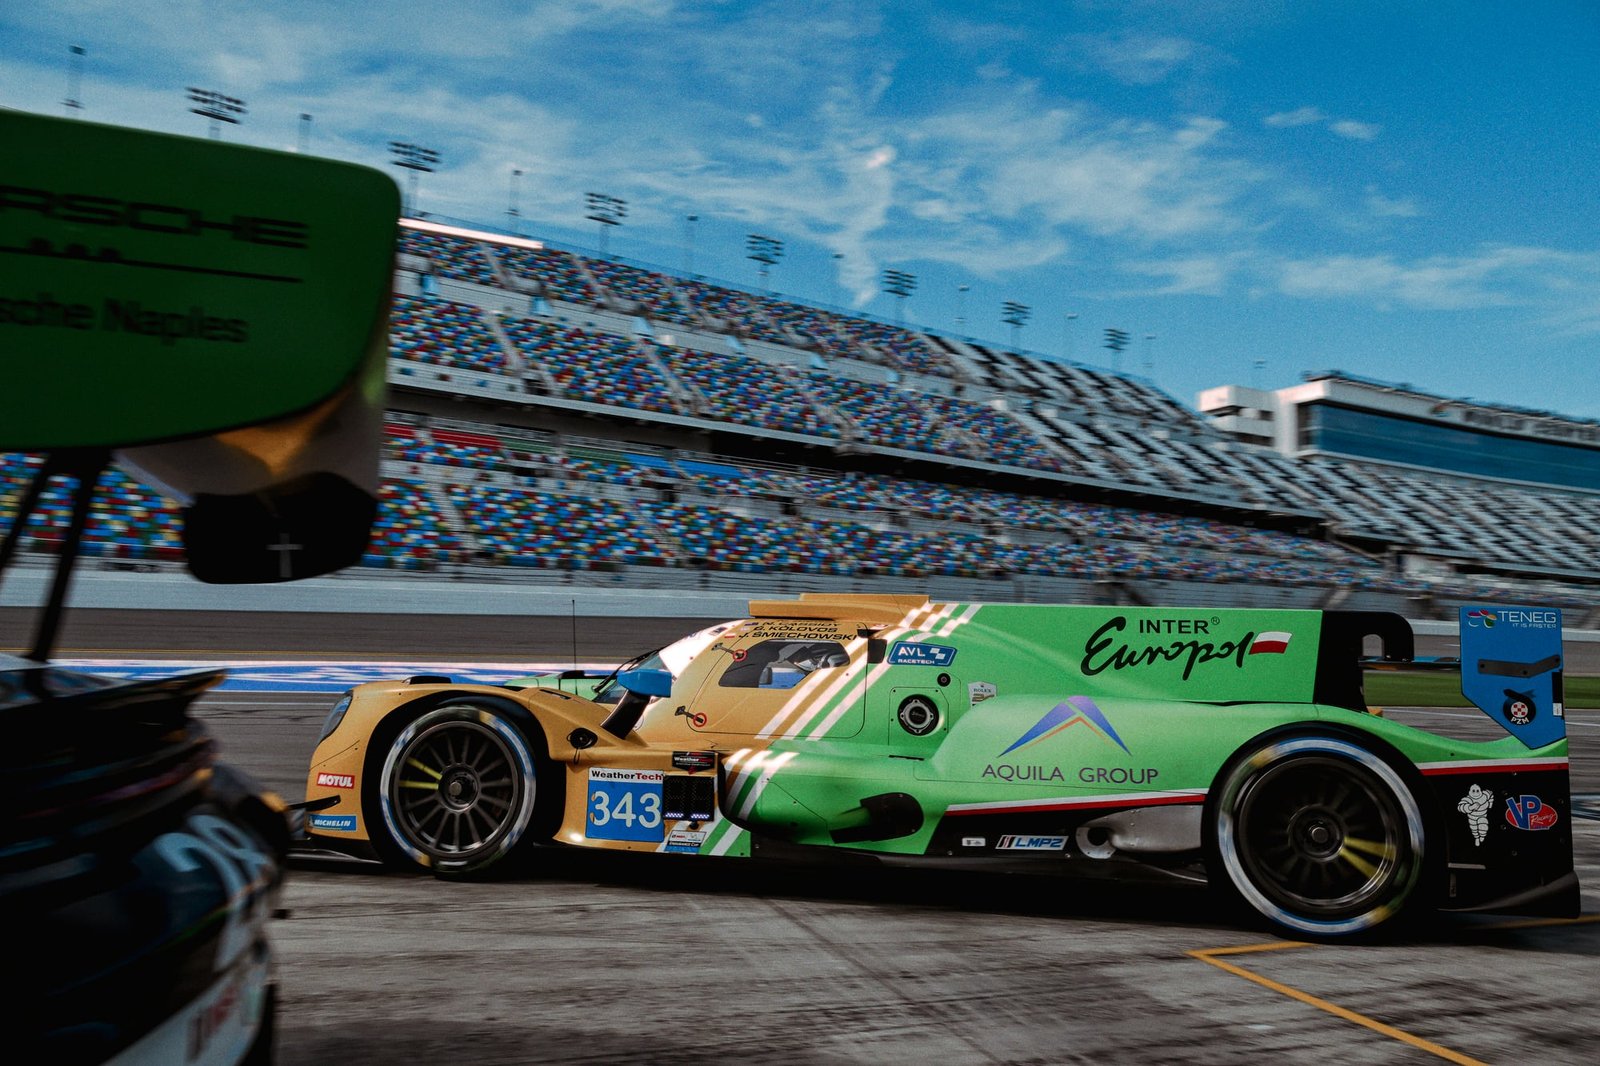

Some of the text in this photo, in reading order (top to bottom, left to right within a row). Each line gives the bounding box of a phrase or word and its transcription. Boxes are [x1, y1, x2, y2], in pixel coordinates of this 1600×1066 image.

[0, 184, 310, 249] RSCHE
[0, 292, 249, 346] sche Naples
[1497, 611, 1556, 623] TENEG
[898, 647, 925, 657] AVL
[1080, 616, 1254, 680] Europol
[1511, 717, 1529, 725] PZM
[317, 774, 353, 787] MOTUL
[591, 770, 662, 780] WeatherTech
[981, 764, 1159, 784] AQUILA GROUP
[590, 791, 661, 828] 343
[1506, 795, 1542, 830] VP
[314, 819, 351, 827] MICHELIN
[1015, 838, 1063, 847] LMP2
